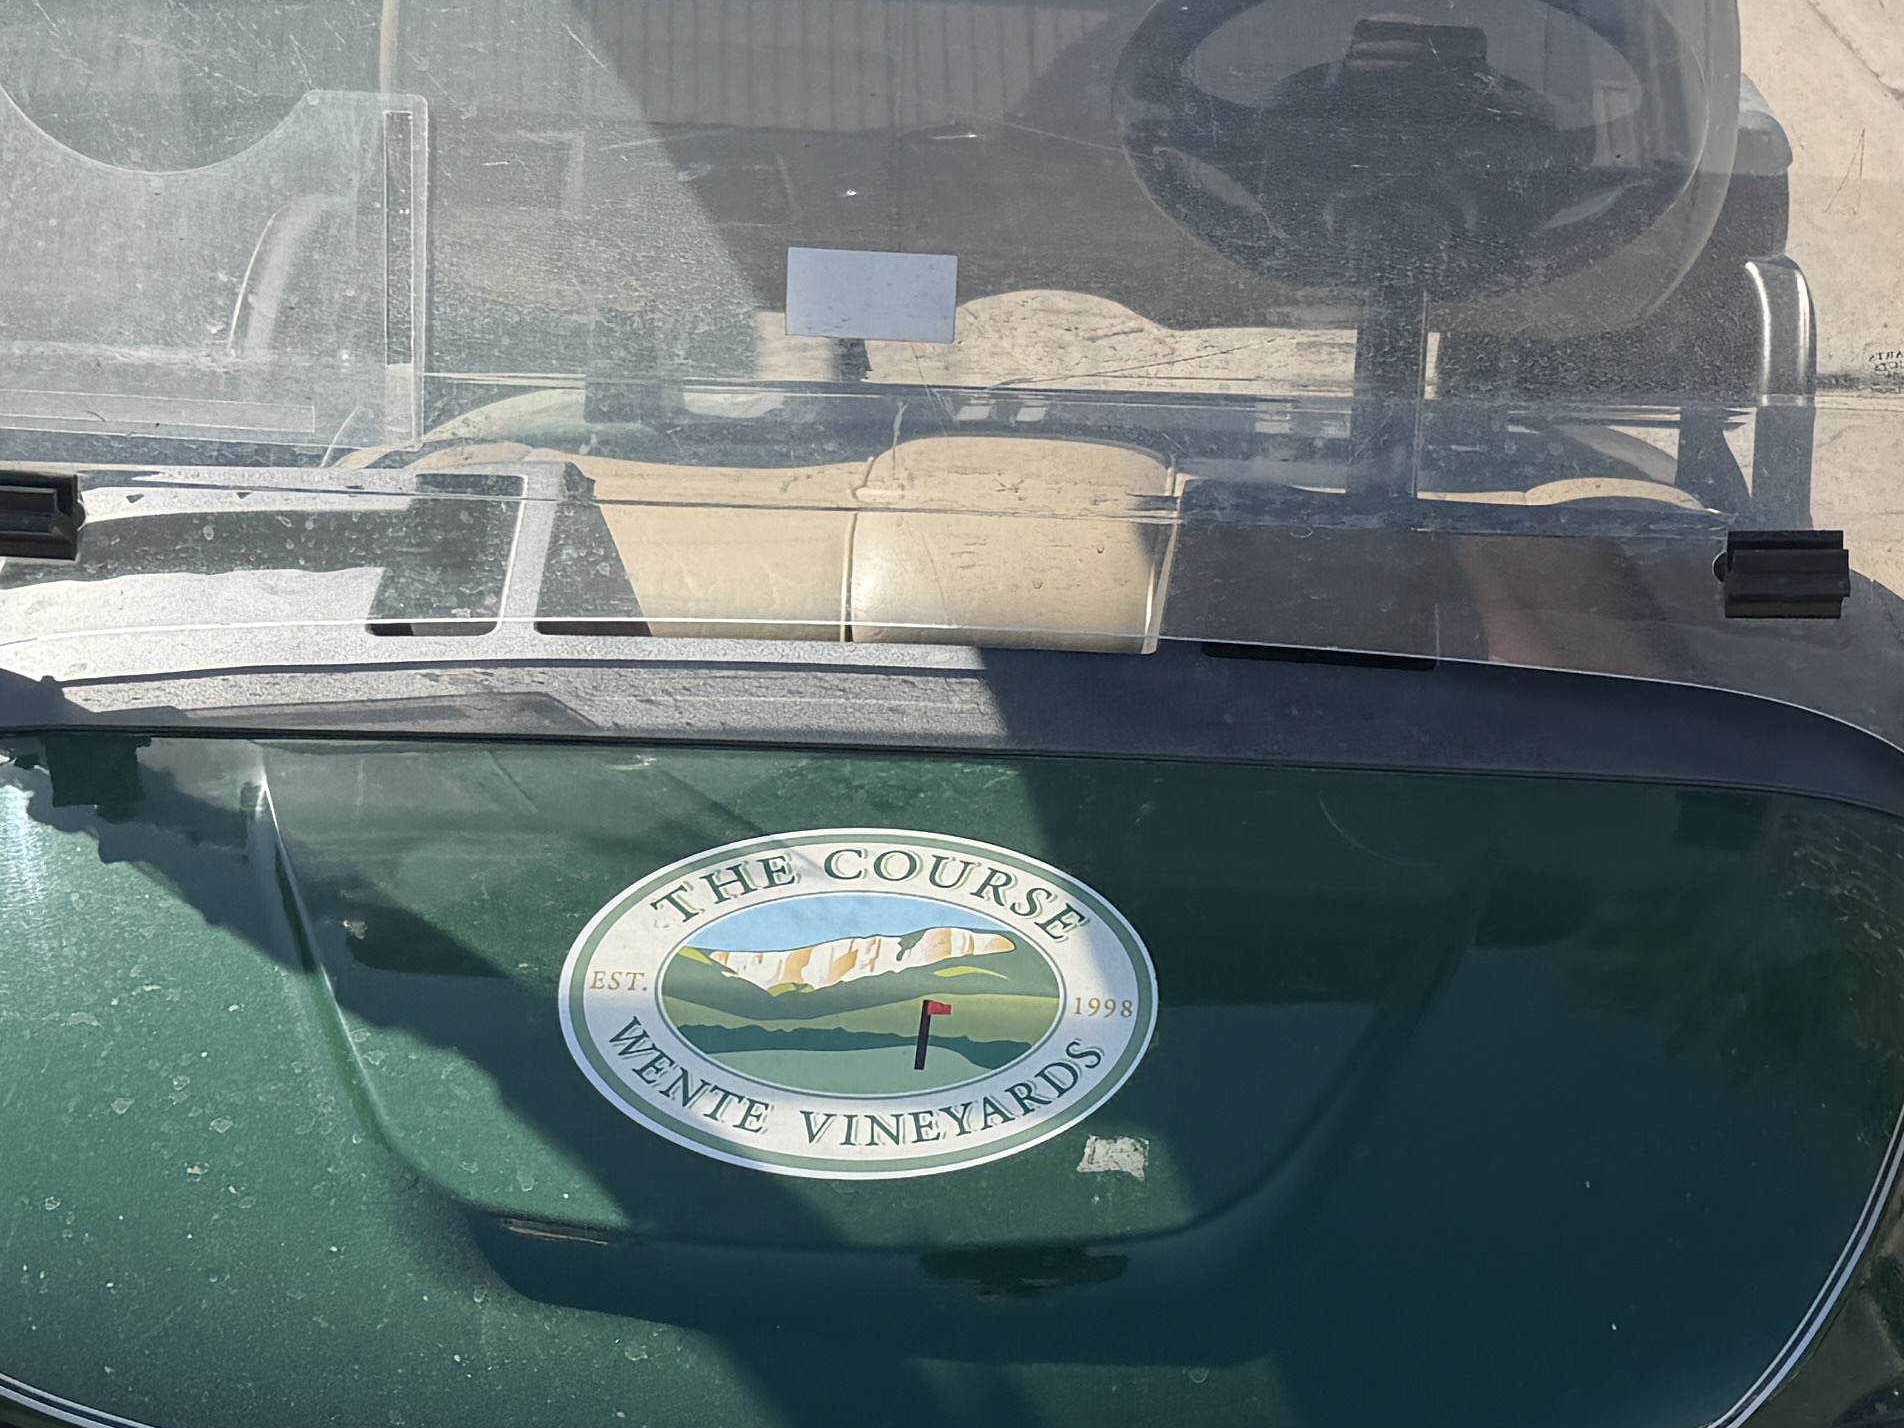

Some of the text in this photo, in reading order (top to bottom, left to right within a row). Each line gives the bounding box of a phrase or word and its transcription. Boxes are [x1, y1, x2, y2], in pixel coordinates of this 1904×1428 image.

[649, 848, 1088, 940] THE COURSE
[589, 970, 1133, 1018] EST. 1998
[608, 1015, 1104, 1147] WENTE VINEYARDS
